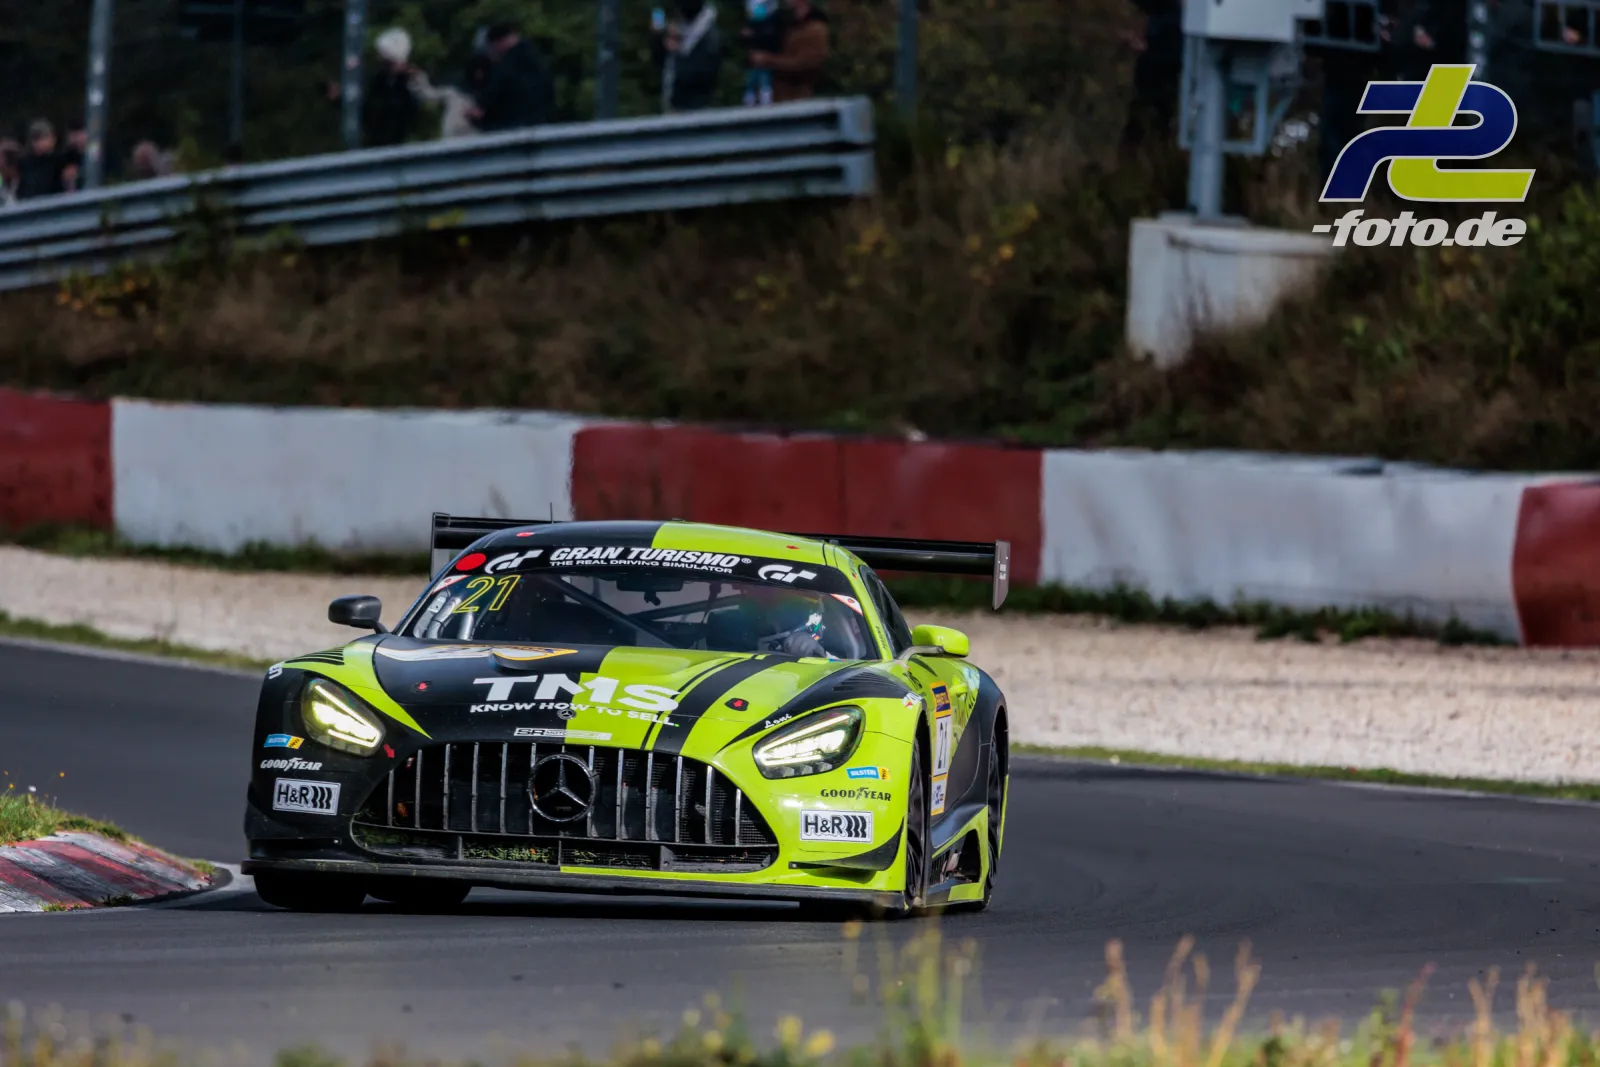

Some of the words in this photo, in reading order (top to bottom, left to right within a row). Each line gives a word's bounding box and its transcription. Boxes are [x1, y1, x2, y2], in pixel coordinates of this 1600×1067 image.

[549, 547, 625, 561] GRAN
[662, 561, 733, 574] SIMULATOR
[452, 574, 521, 613] 21
[472, 673, 681, 712] TMS
[470, 702, 535, 713] KNOW
[539, 701, 590, 712] HOW
[596, 707, 622, 716] TO
[260, 757, 323, 772] GOODYEAR
[277, 783, 310, 805] H&R
[820, 787, 892, 802] GOODYEAR
[804, 813, 843, 835] H&R
